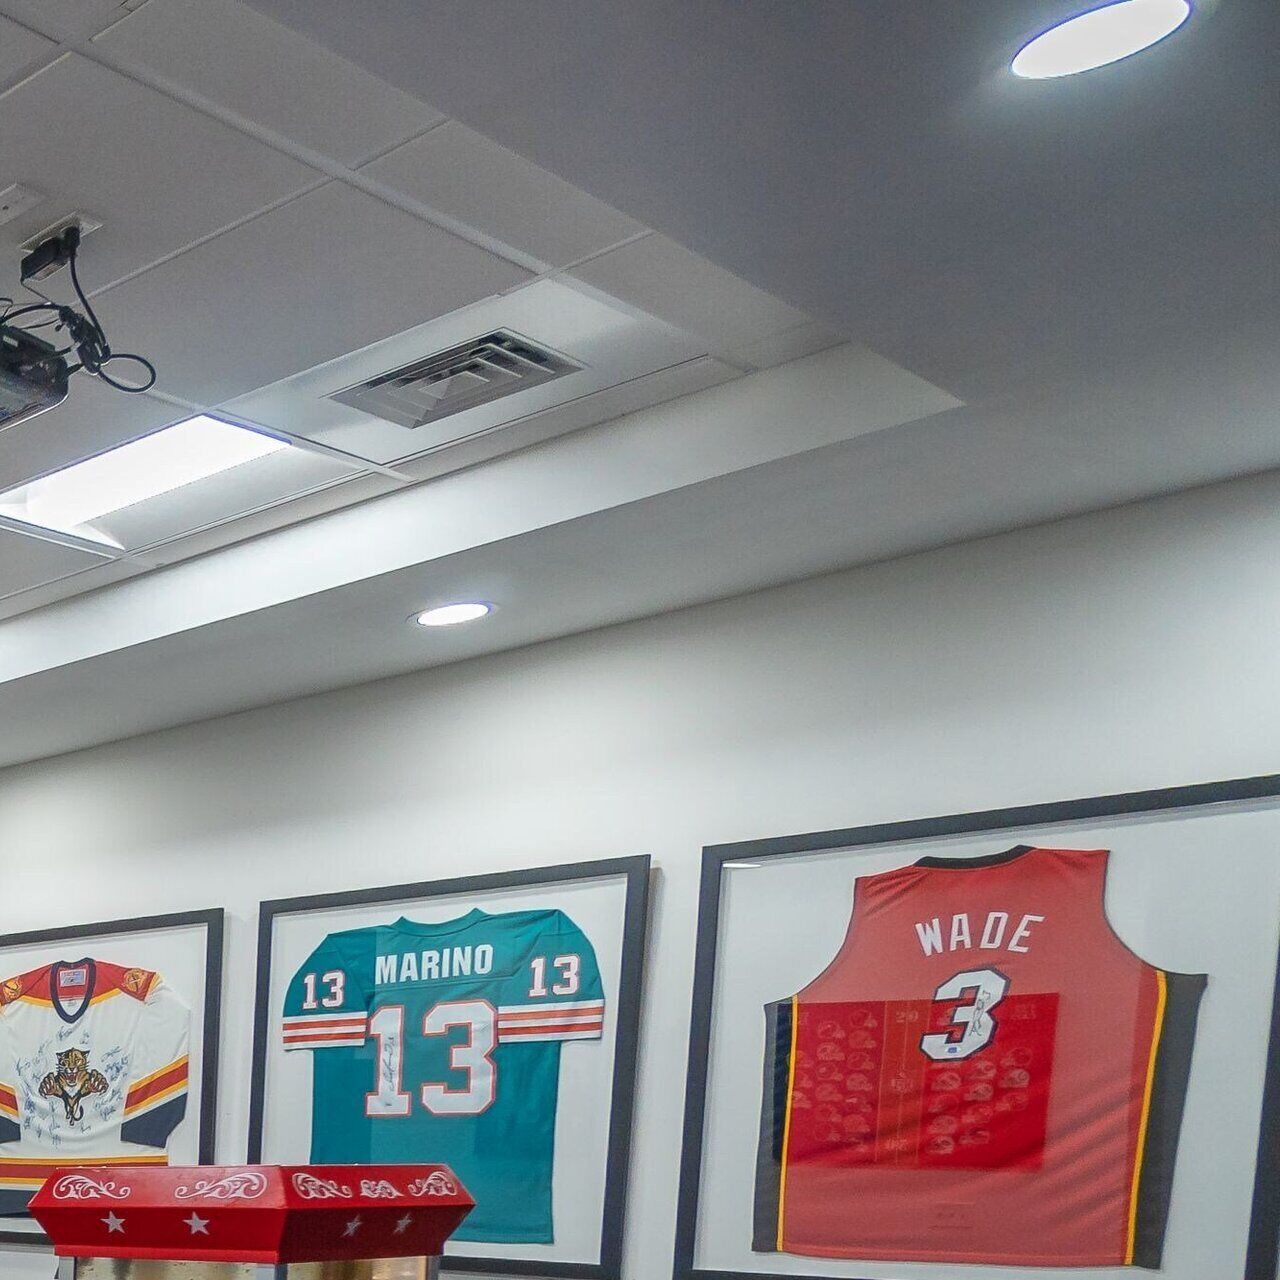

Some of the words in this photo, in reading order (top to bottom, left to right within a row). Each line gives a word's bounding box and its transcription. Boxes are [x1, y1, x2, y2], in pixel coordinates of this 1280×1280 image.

[914, 911, 1046, 957] WADE
[300, 969, 347, 1010] 13
[528, 953, 581, 998] 13
[375, 943, 495, 985] MARINO
[919, 966, 1011, 1062] 3
[364, 998, 500, 1117] 13
